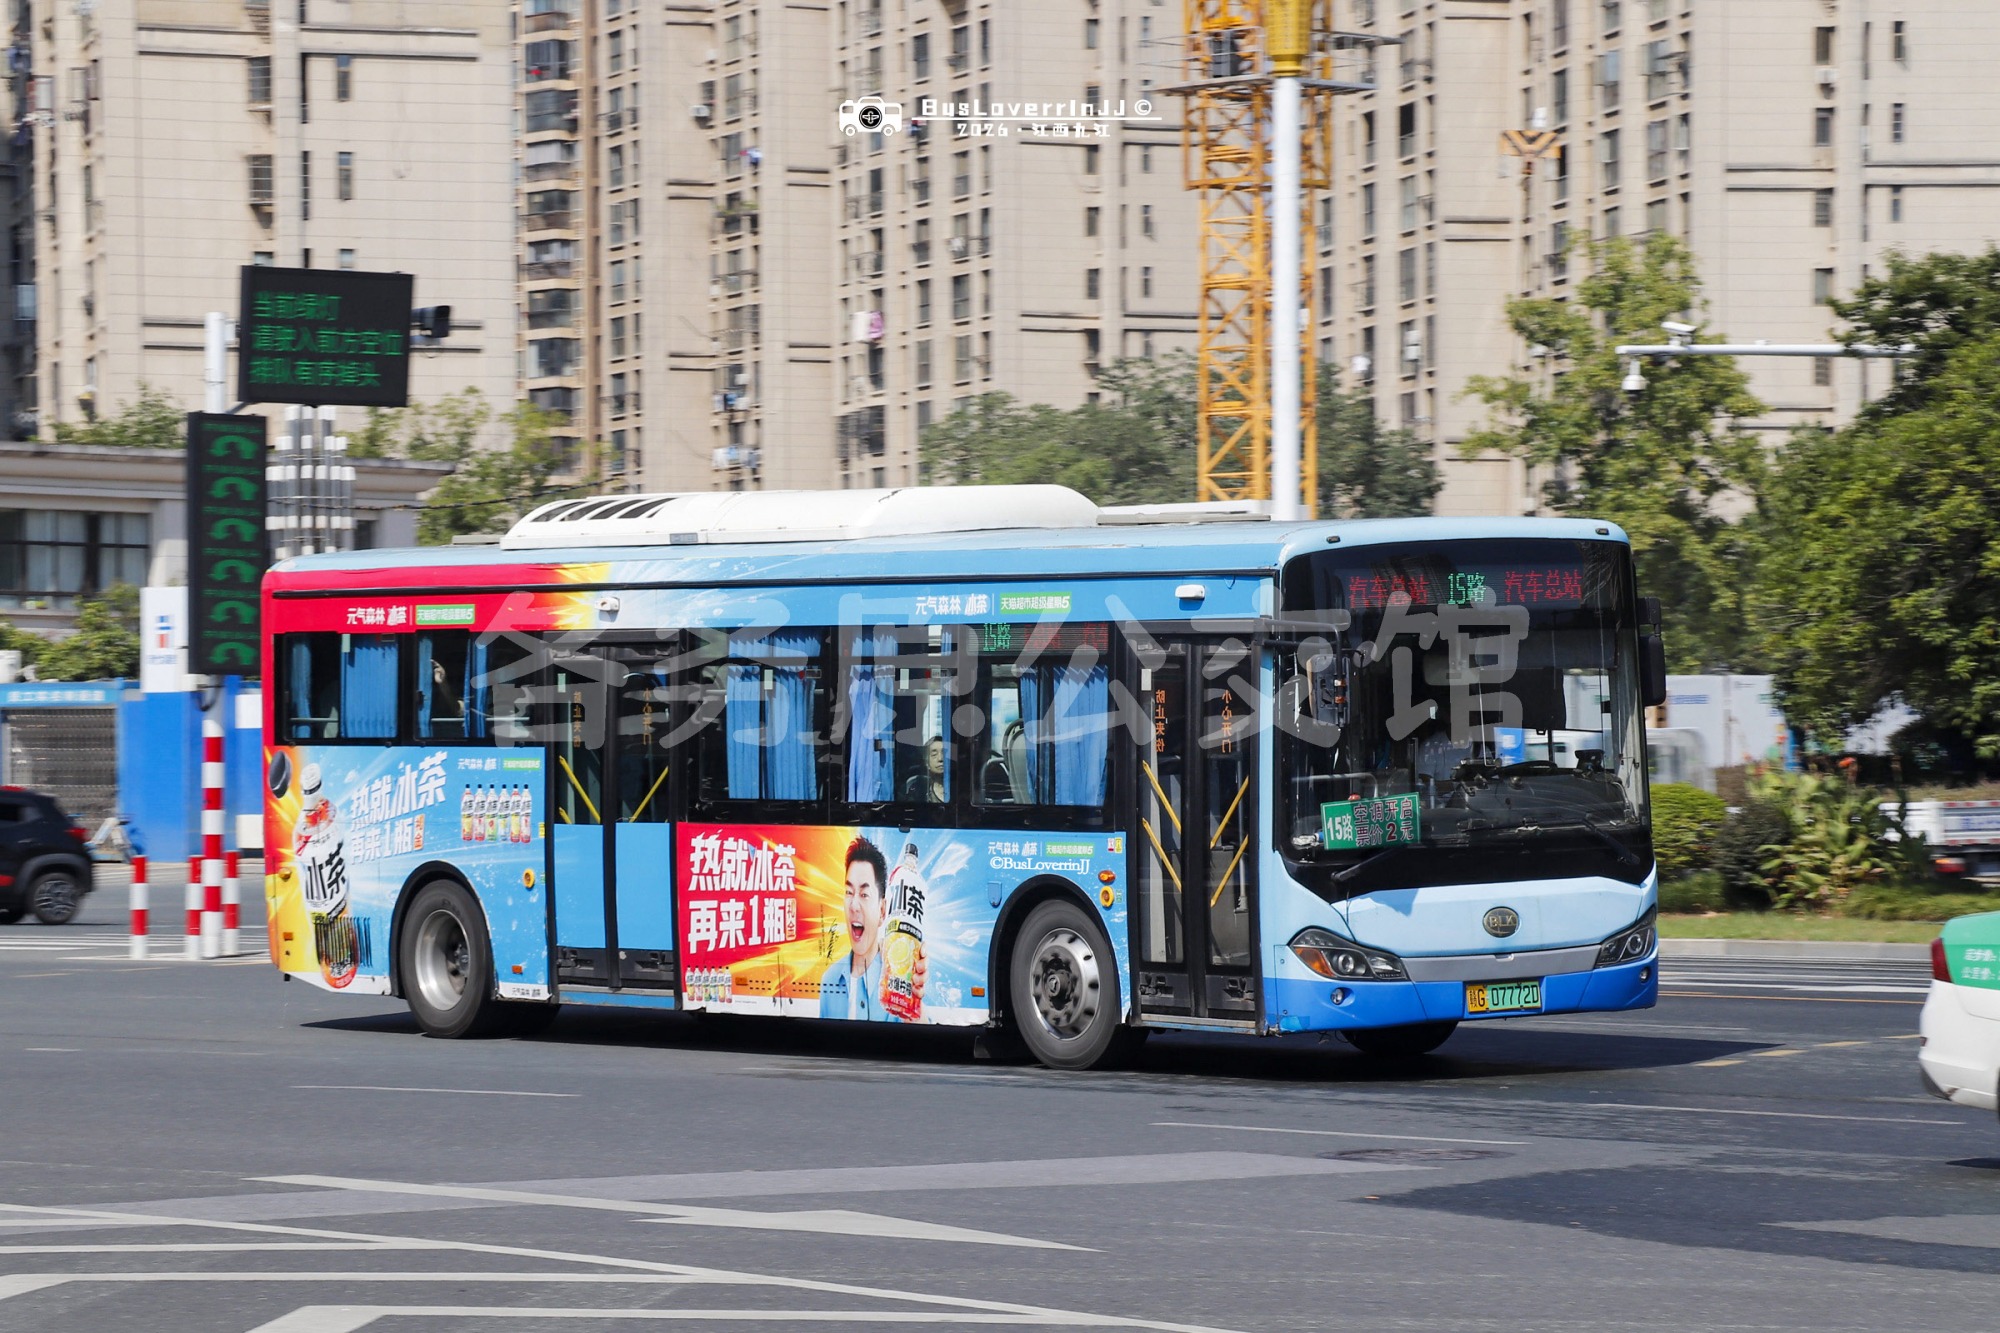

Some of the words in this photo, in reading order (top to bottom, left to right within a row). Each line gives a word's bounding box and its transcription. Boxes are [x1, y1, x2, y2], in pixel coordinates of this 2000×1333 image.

[1447, 572, 1487, 605] 15路
[1504, 569, 1583, 602] 汽车总站
[915, 596, 961, 615] 元气森林
[350, 750, 448, 833] 热就冰茶
[1327, 813, 1353, 841] 15路
[1354, 797, 1413, 826] 空调开启
[1355, 821, 1414, 847] 票价2元
[688, 829, 796, 891] 热就冰茶
[688, 894, 785, 954] 再来1瓶
